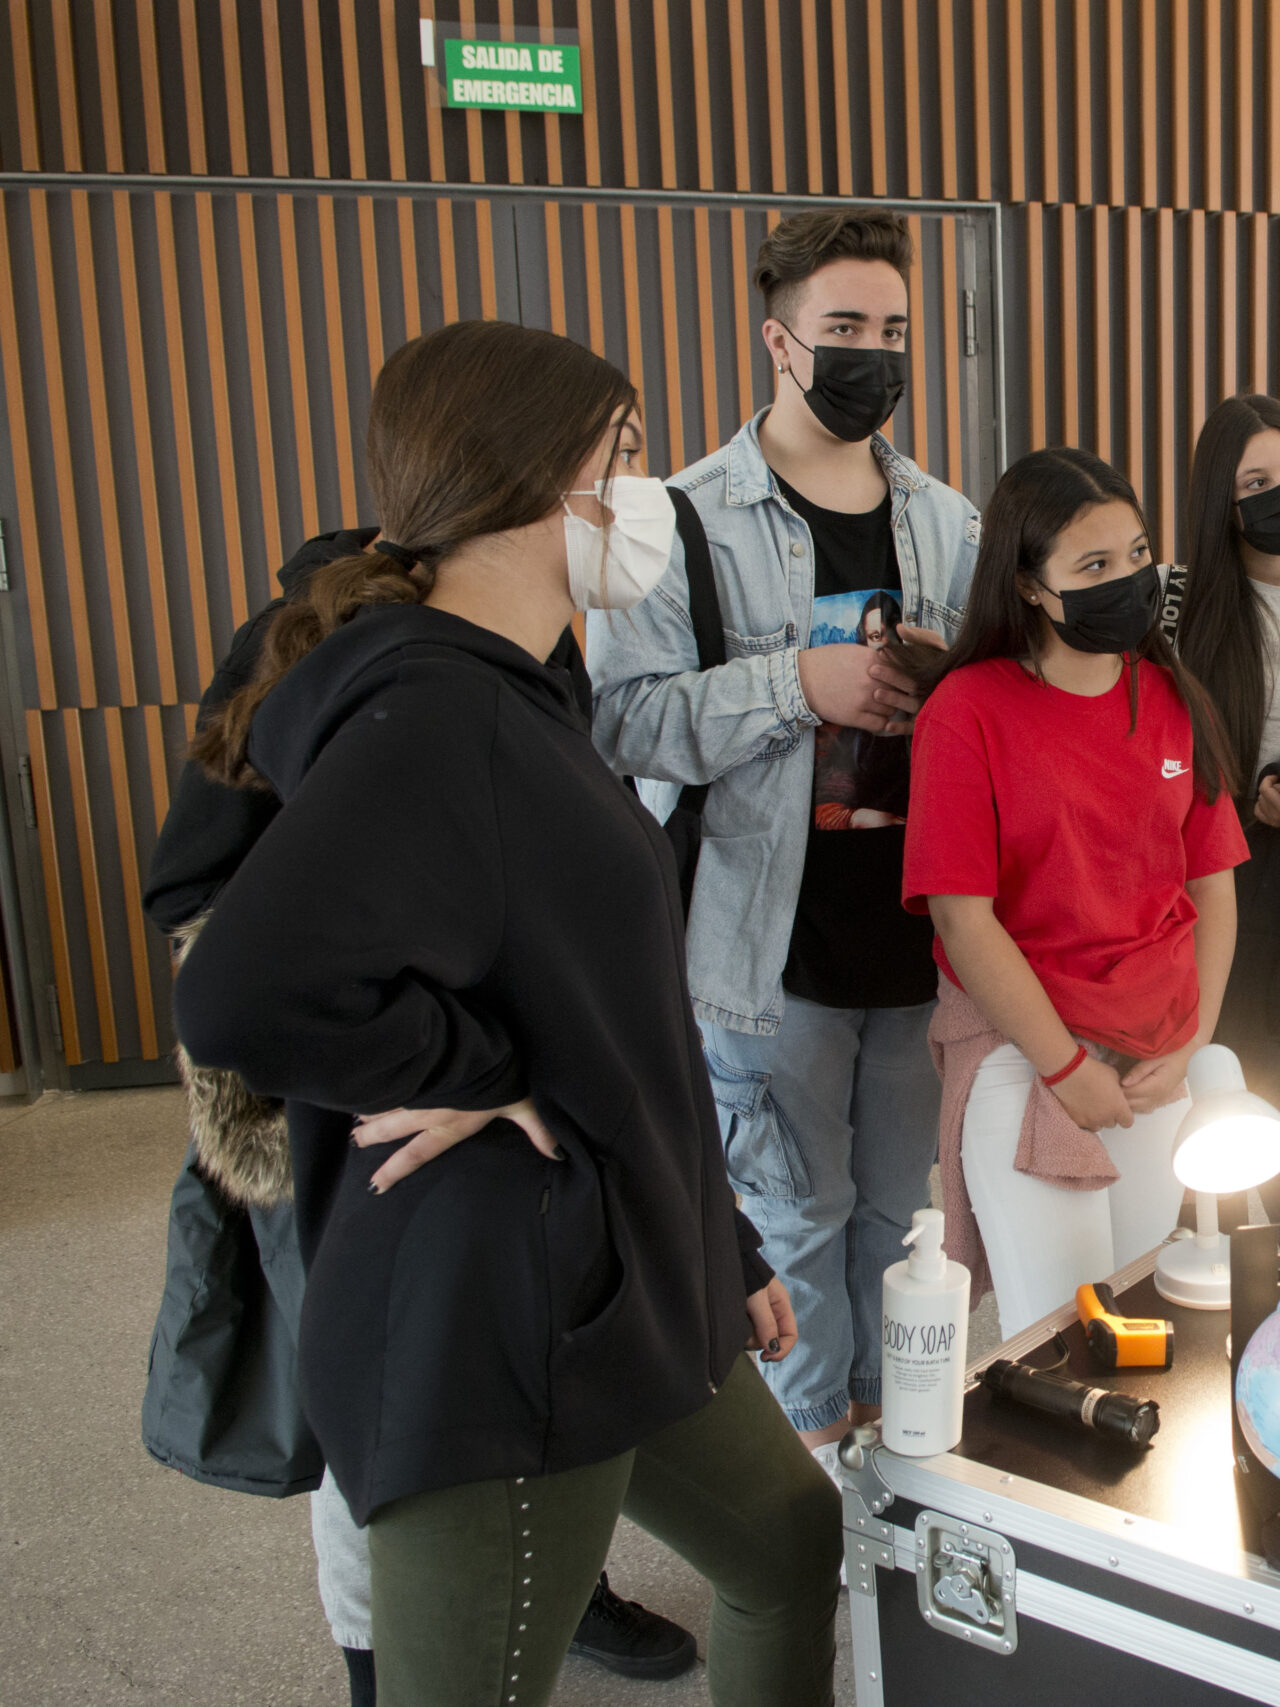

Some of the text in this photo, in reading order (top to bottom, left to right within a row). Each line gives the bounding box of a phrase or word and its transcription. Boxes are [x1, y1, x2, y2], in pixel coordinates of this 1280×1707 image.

[461, 44, 563, 73] SALIDA DE
[452, 78, 576, 108] EMERGENCIA
[1163, 758, 1183, 772] NIKE
[884, 1315, 956, 1354] BODY SOAP
